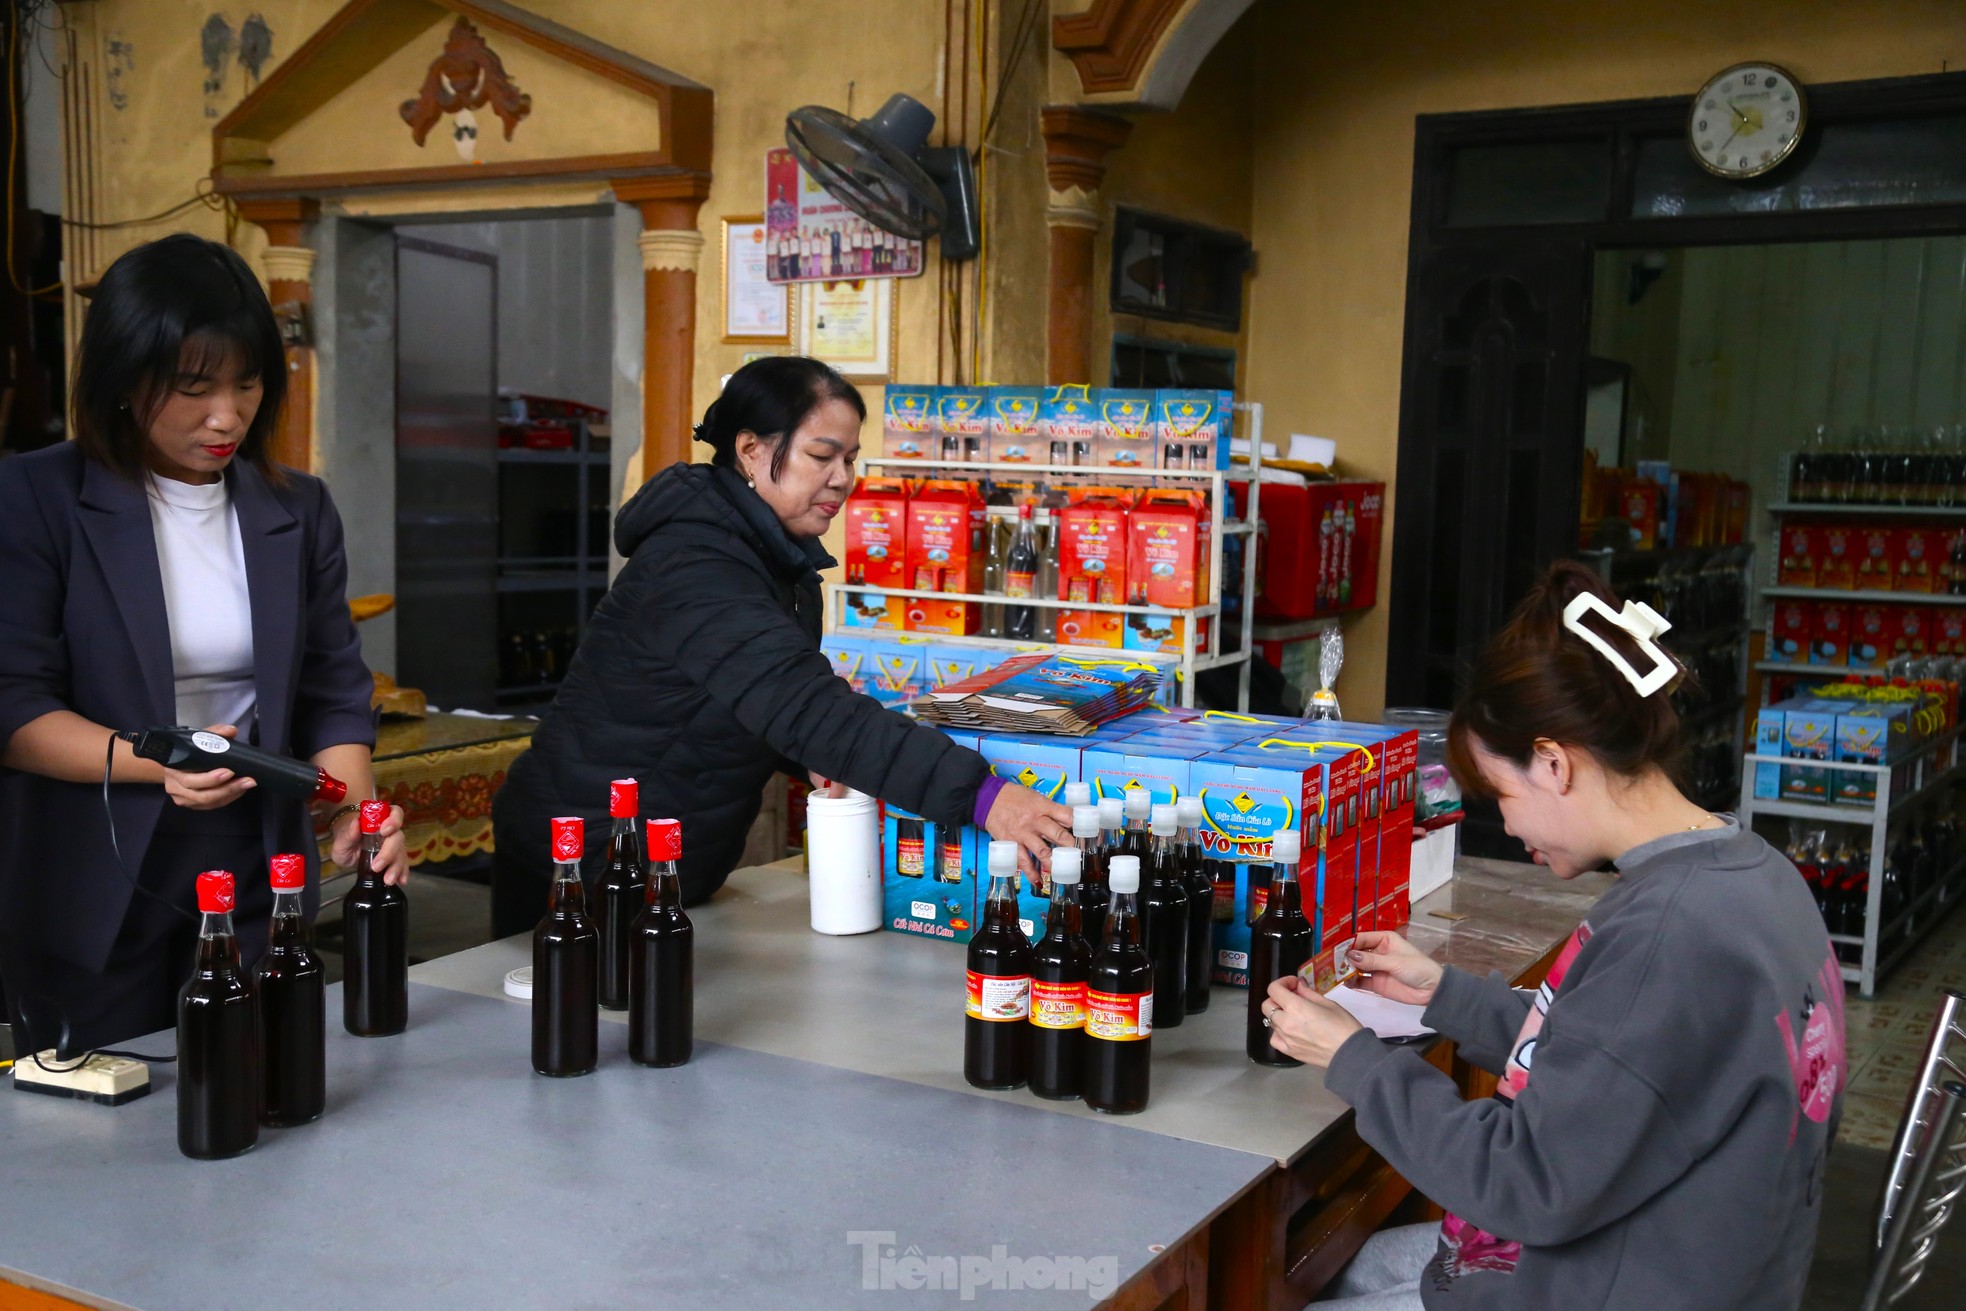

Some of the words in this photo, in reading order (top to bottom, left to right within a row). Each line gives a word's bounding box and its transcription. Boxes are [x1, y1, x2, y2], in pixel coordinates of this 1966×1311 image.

[1742, 73, 1757, 86] 12
[1786, 110, 1795, 123] 3
[1699, 120, 1708, 132] 9
[1739, 156, 1748, 168] 6
[1068, 426, 1092, 438] Kim
[913, 902, 934, 912] OCOP
[1221, 950, 1246, 960] OCOP
[1053, 1002, 1075, 1012] Kim
[1103, 1011, 1124, 1023] Kim
